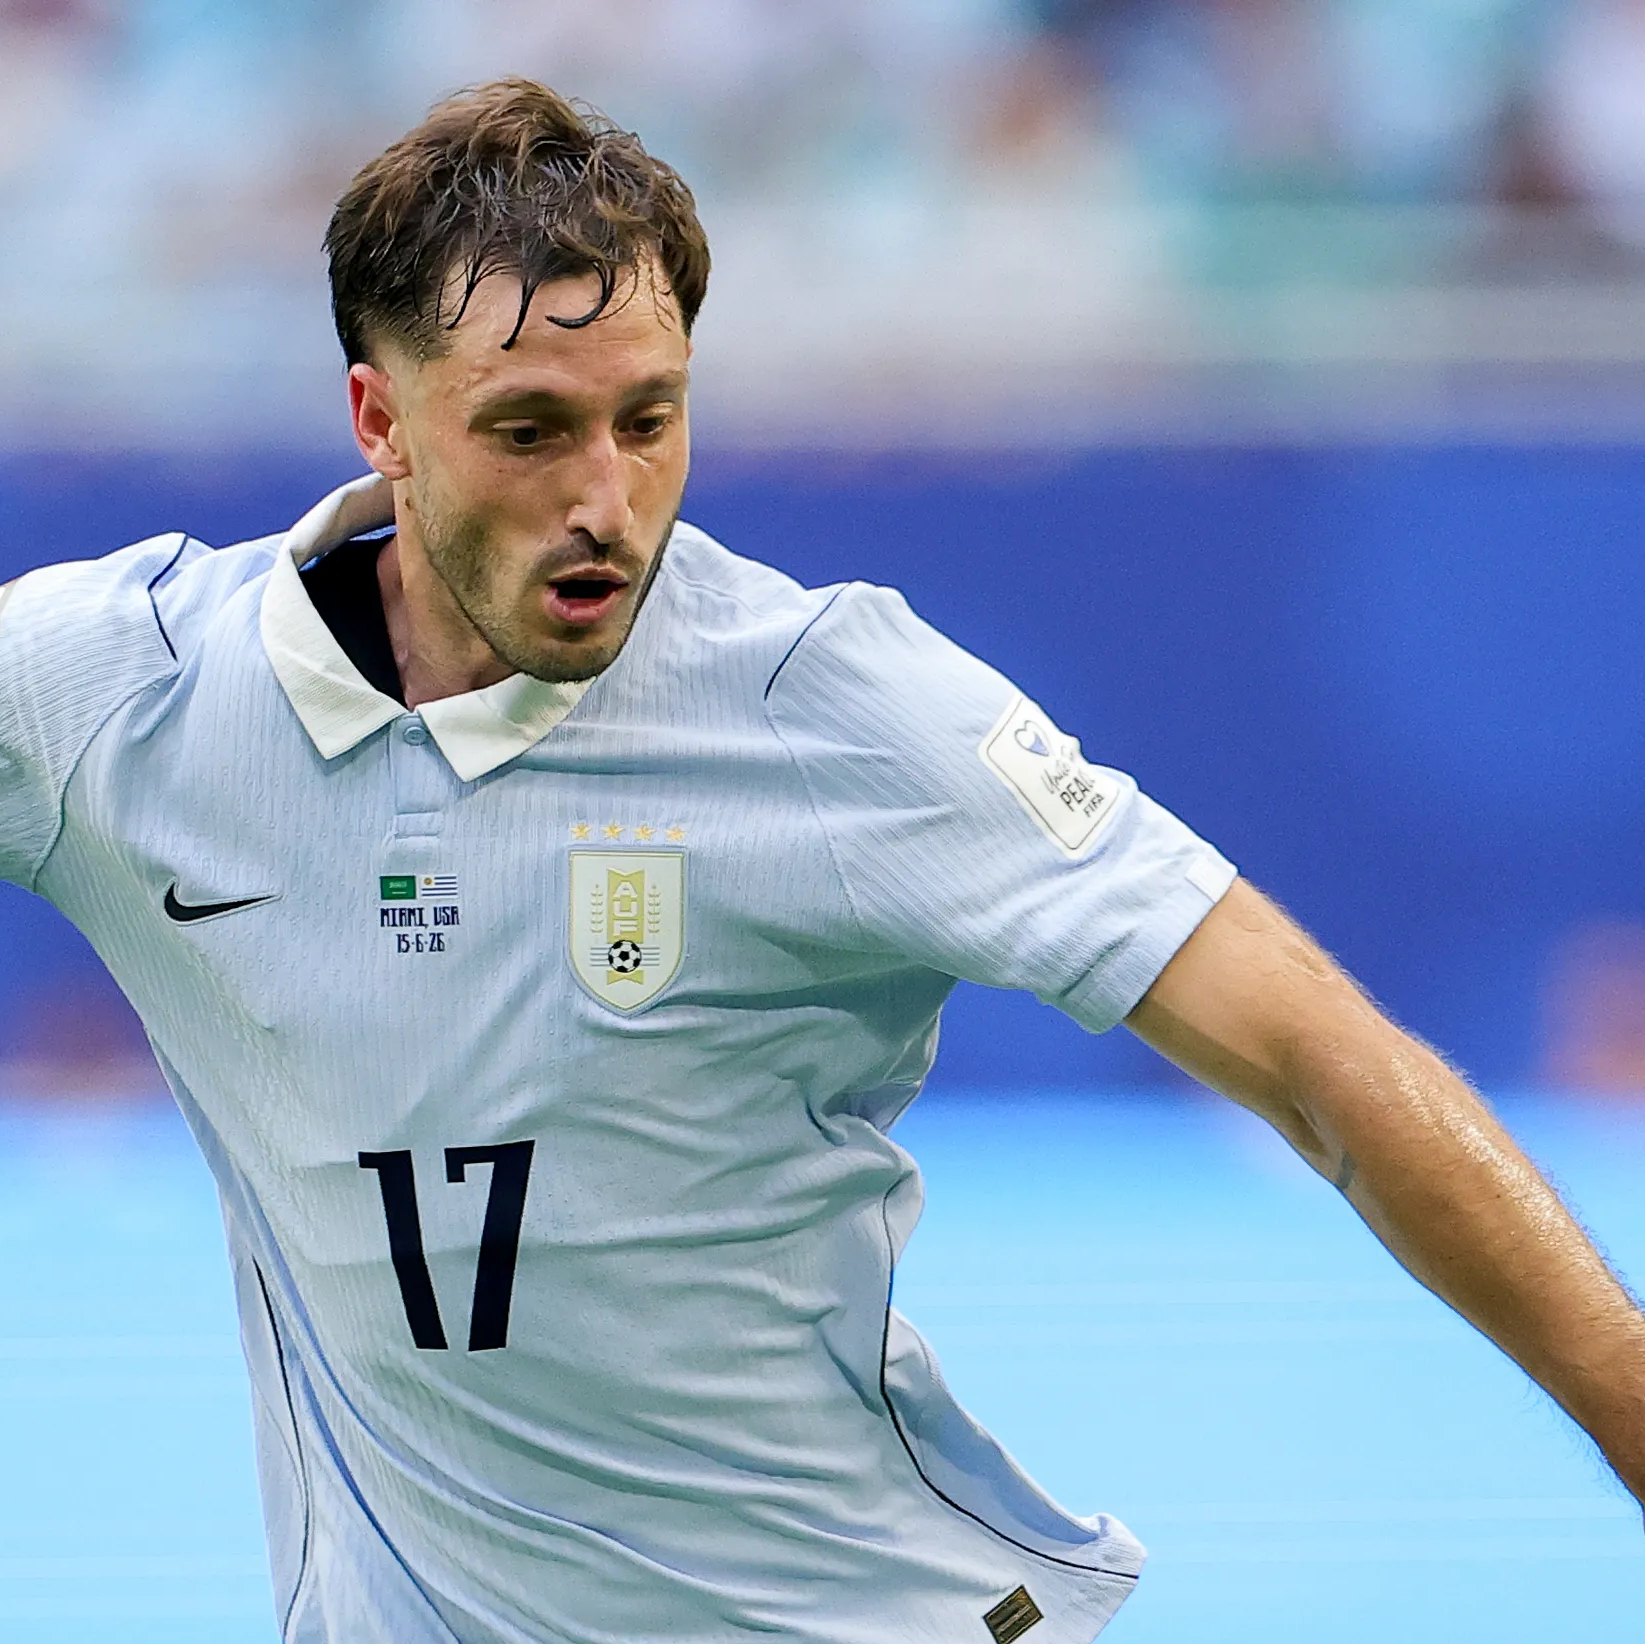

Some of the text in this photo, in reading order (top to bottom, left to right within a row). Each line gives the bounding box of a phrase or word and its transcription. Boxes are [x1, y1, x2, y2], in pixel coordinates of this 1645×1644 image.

[380, 905, 460, 930] MIAMI, USA
[613, 881, 638, 937] AUF
[358, 1139, 535, 1351] 17
